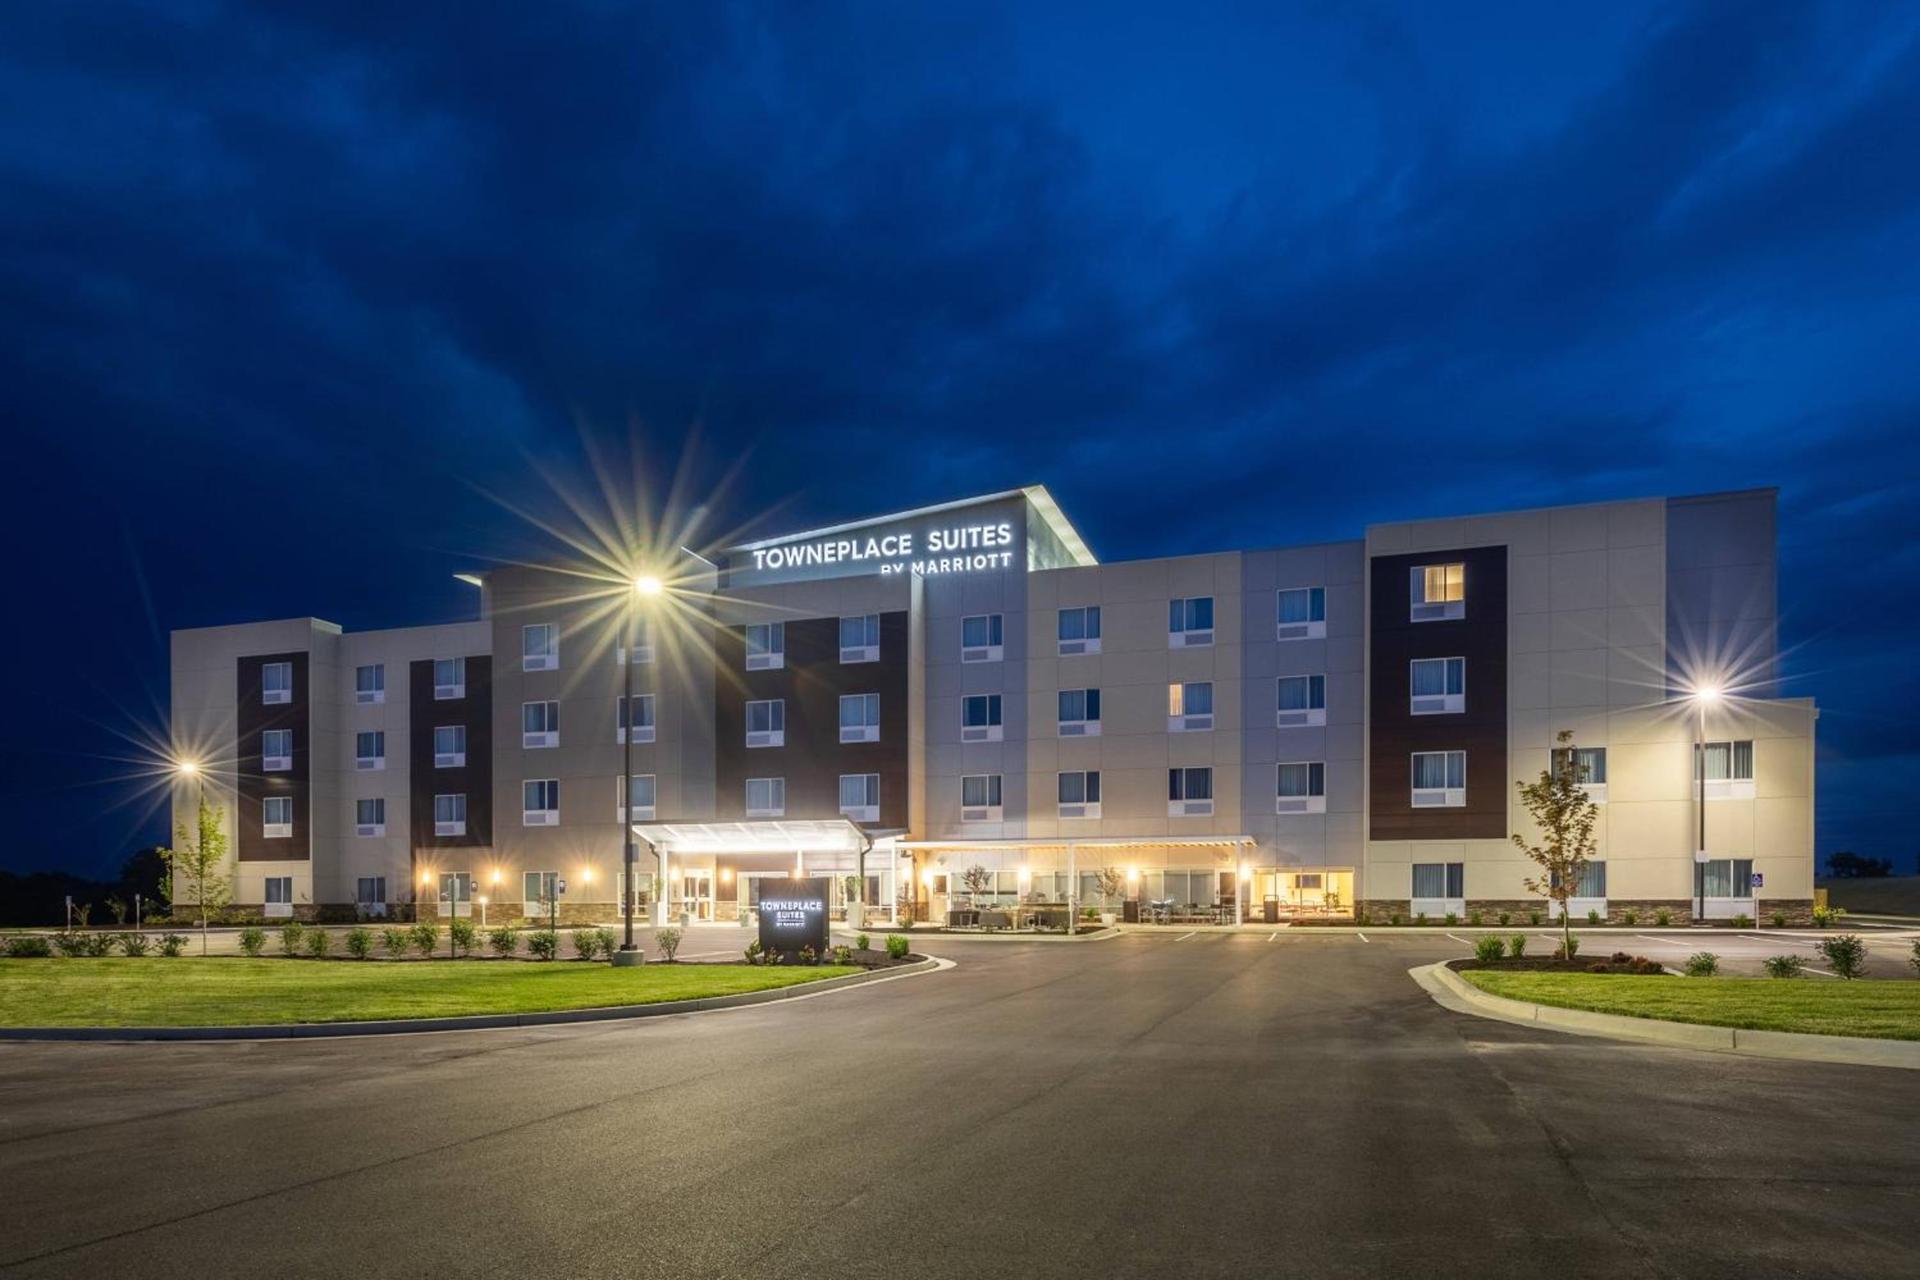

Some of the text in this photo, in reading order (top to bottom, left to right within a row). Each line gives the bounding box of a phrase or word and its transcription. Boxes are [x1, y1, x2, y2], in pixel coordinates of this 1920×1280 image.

[753, 524, 1012, 570] TOWNEPLACE SUITES
[911, 552, 1012, 575] MARRIOTT
[760, 901, 823, 911] TOWNEPLACE
[776, 911, 805, 919] SUITES
